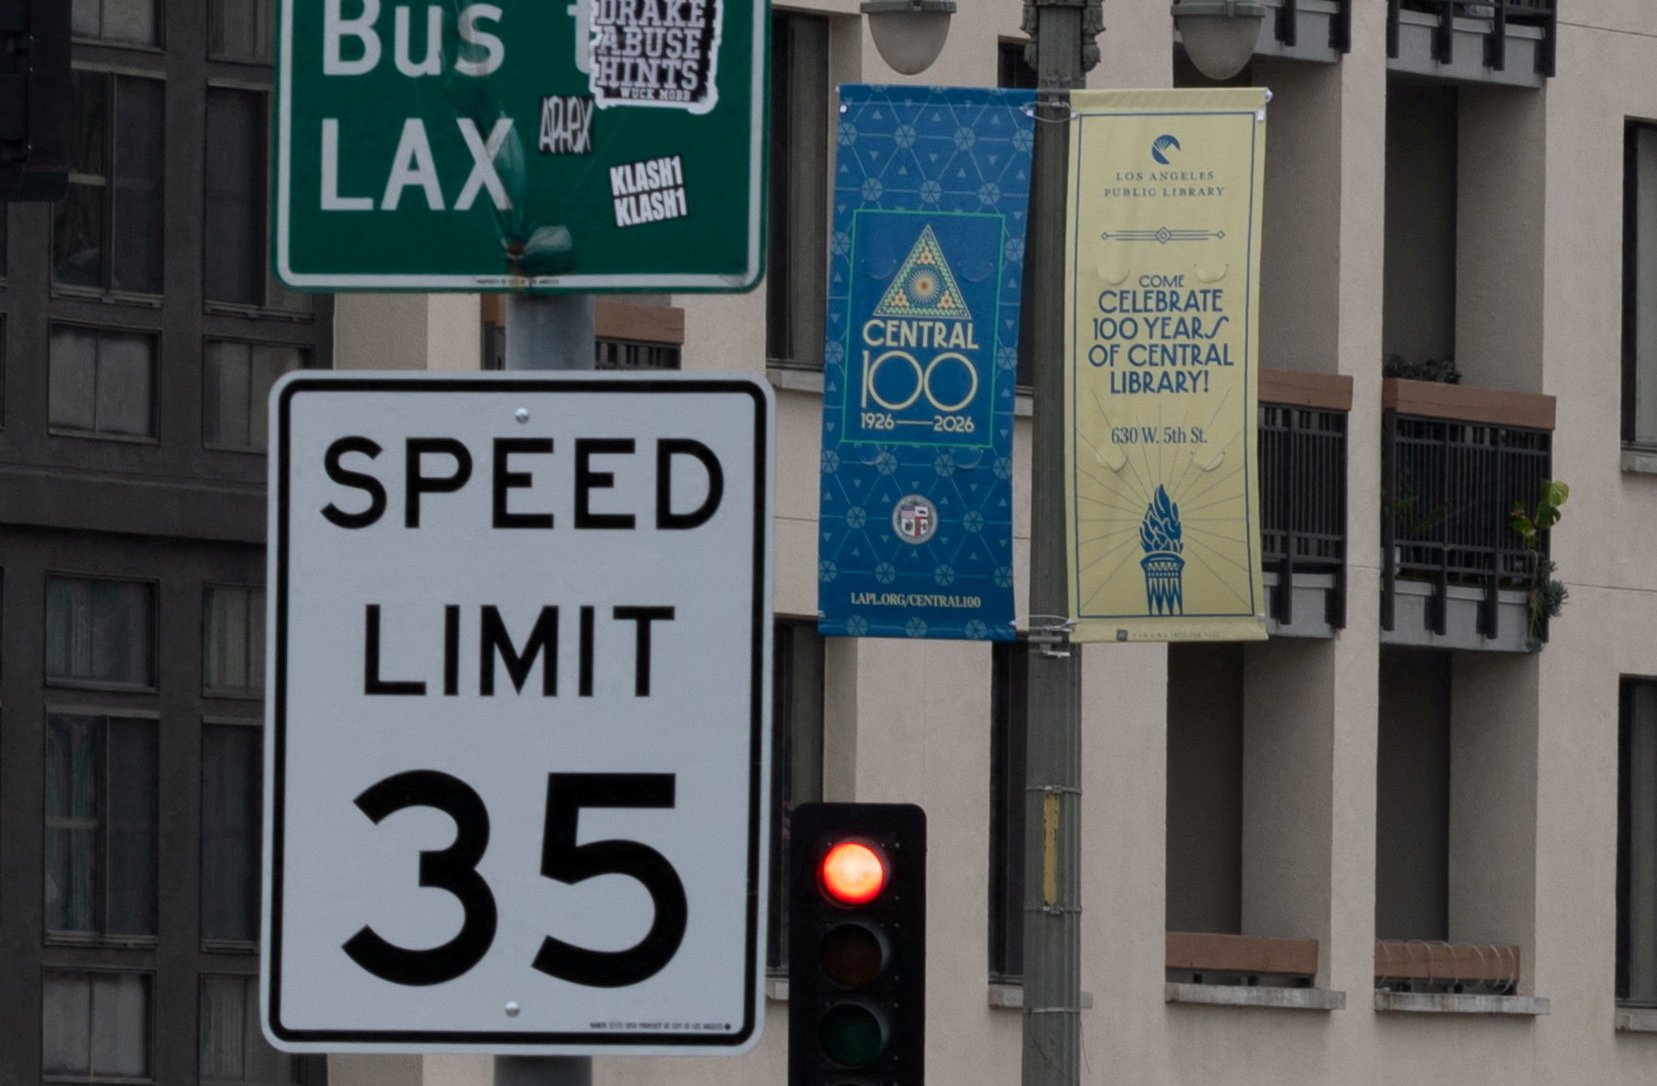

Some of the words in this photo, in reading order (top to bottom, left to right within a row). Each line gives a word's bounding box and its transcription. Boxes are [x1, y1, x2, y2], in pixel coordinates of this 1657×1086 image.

[596, 0, 706, 28] DRAKE
[321, 0, 507, 77] Bus
[597, 26, 701, 59] ABUSE
[595, 55, 699, 90] HINTS
[320, 118, 513, 211] LAX
[609, 155, 684, 197] KLASH1
[1115, 171, 1144, 182] LOS
[1148, 171, 1215, 182] ANGELES
[613, 186, 689, 228] KLASH1
[1104, 187, 1157, 198] PUBLIC
[1162, 186, 1225, 198] LIBRARY
[1138, 274, 1185, 289] COME
[1098, 289, 1224, 314] CELEBRATE
[862, 320, 980, 350] CENTRAL
[1092, 317, 1138, 341] 100
[1144, 316, 1230, 341] YEARS
[1087, 344, 1122, 369] OF
[1127, 343, 1235, 368] CENTRAL
[861, 349, 979, 411] 100
[1109, 369, 1210, 395] LIBRARY!
[860, 412, 895, 431] 1926
[933, 414, 975, 434] 2026
[1110, 426, 1140, 445] 630
[1141, 426, 1161, 445] W.
[1162, 426, 1188, 444] 5th
[1190, 426, 1208, 444] St.
[320, 436, 725, 531] SPEED
[363, 603, 675, 698] LIMIT
[340, 768, 688, 989] 35
